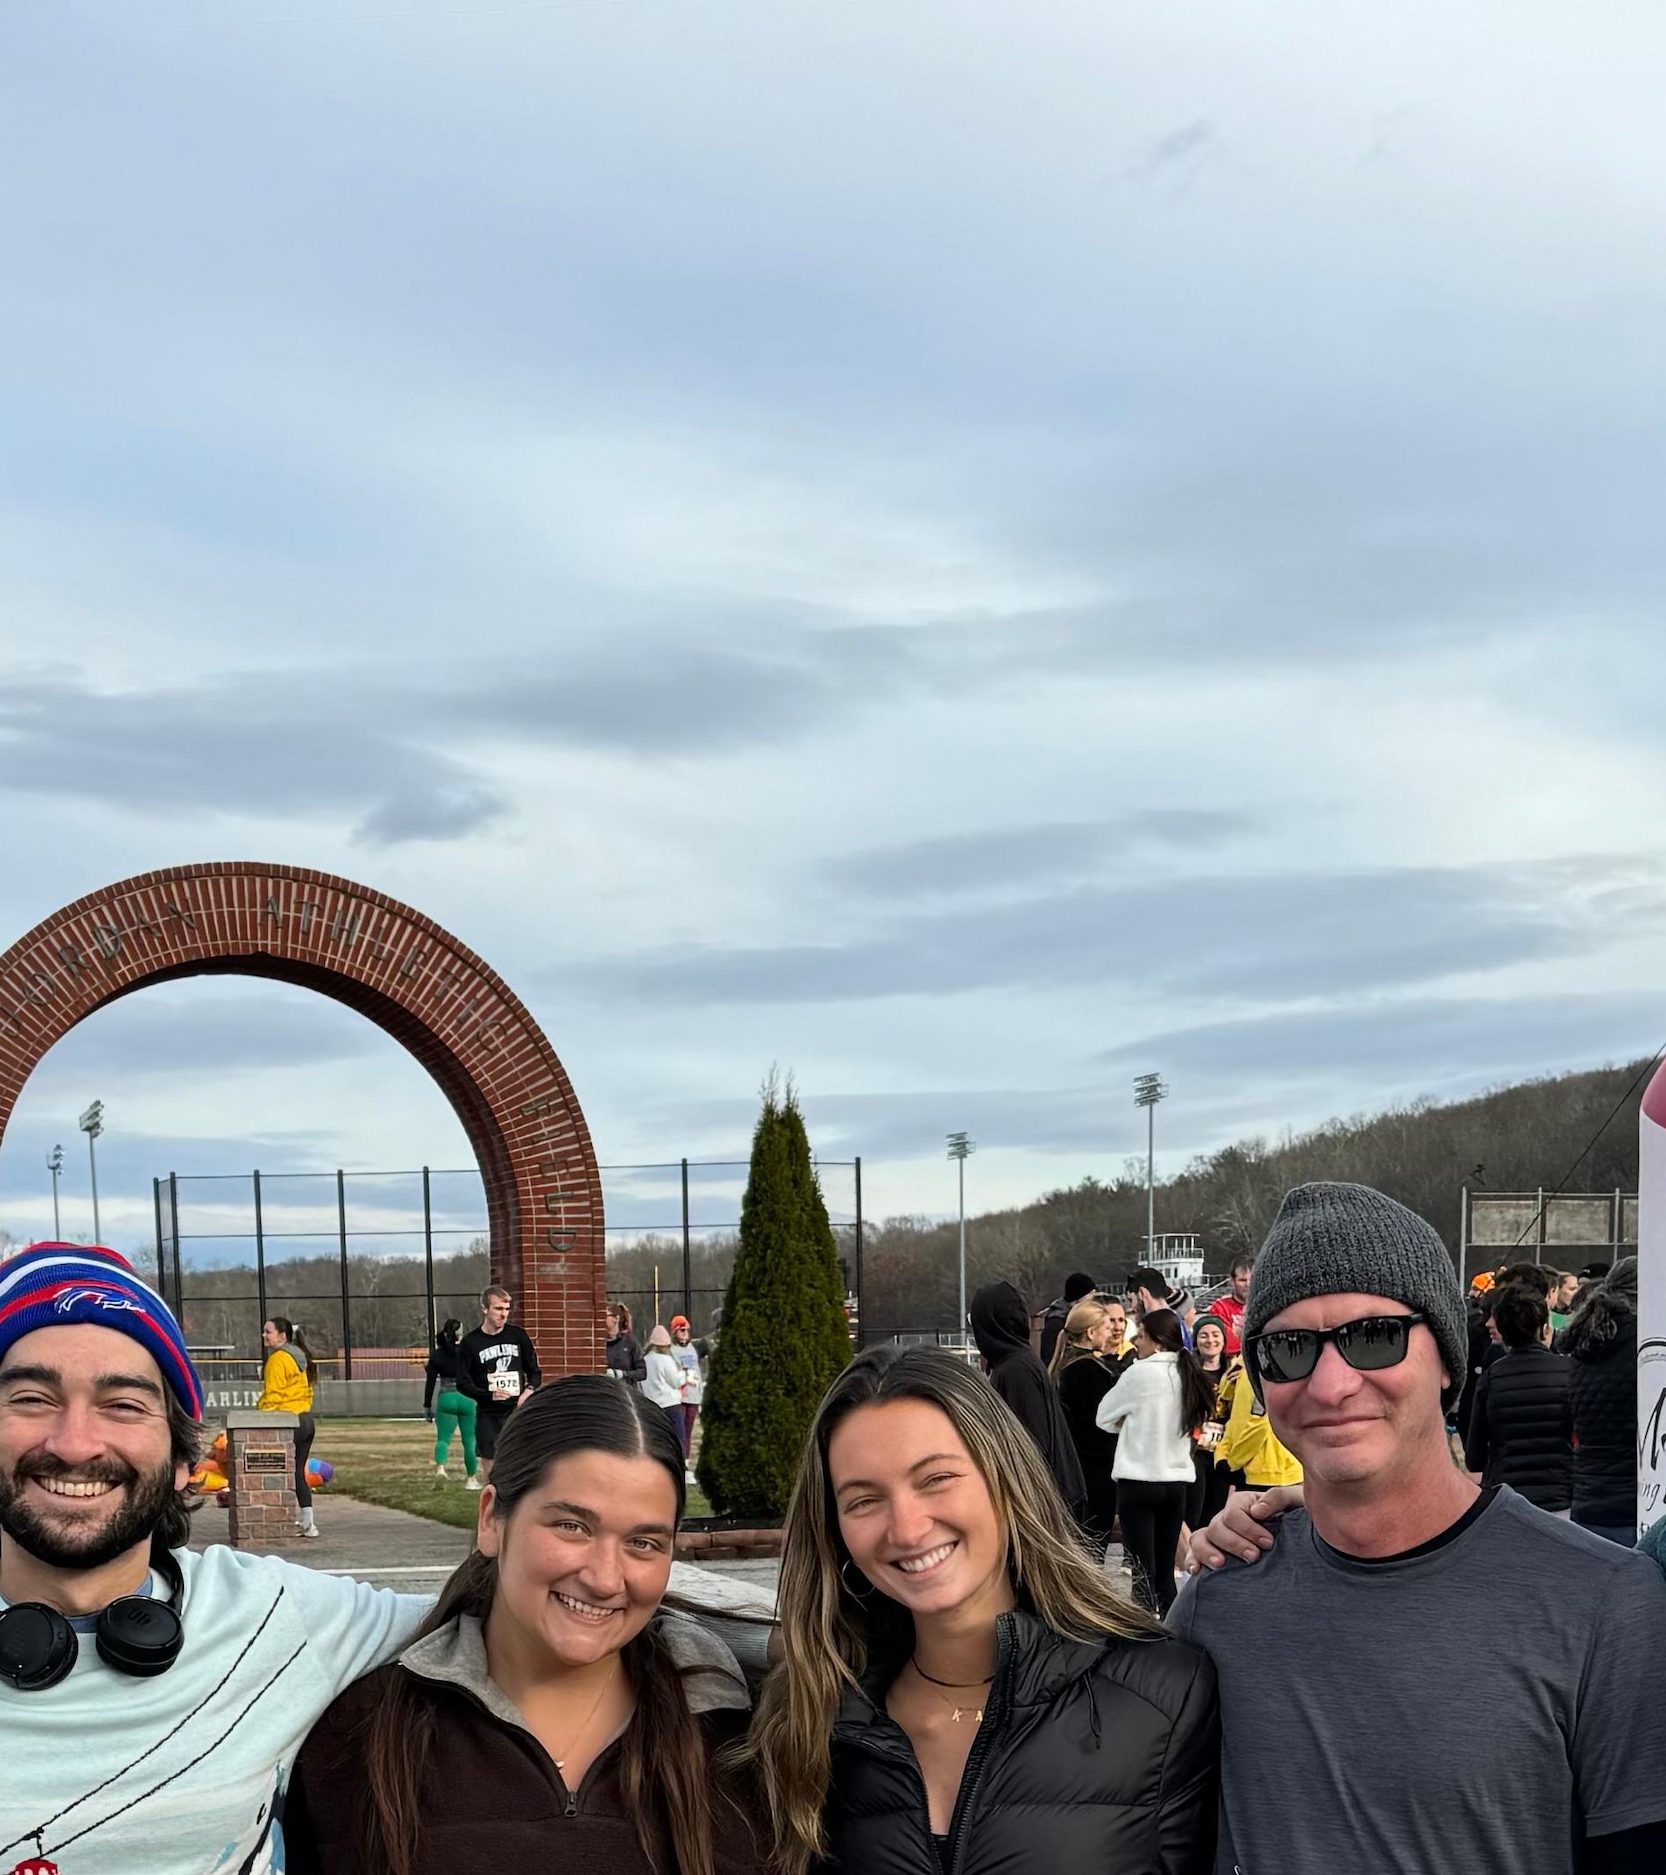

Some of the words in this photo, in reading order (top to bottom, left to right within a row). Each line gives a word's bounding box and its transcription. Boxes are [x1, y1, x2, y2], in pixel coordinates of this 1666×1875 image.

[0, 900, 197, 1038] JORDAN
[258, 898, 508, 1051] ATHLETIC
[521, 1099, 577, 1252] FIELD
